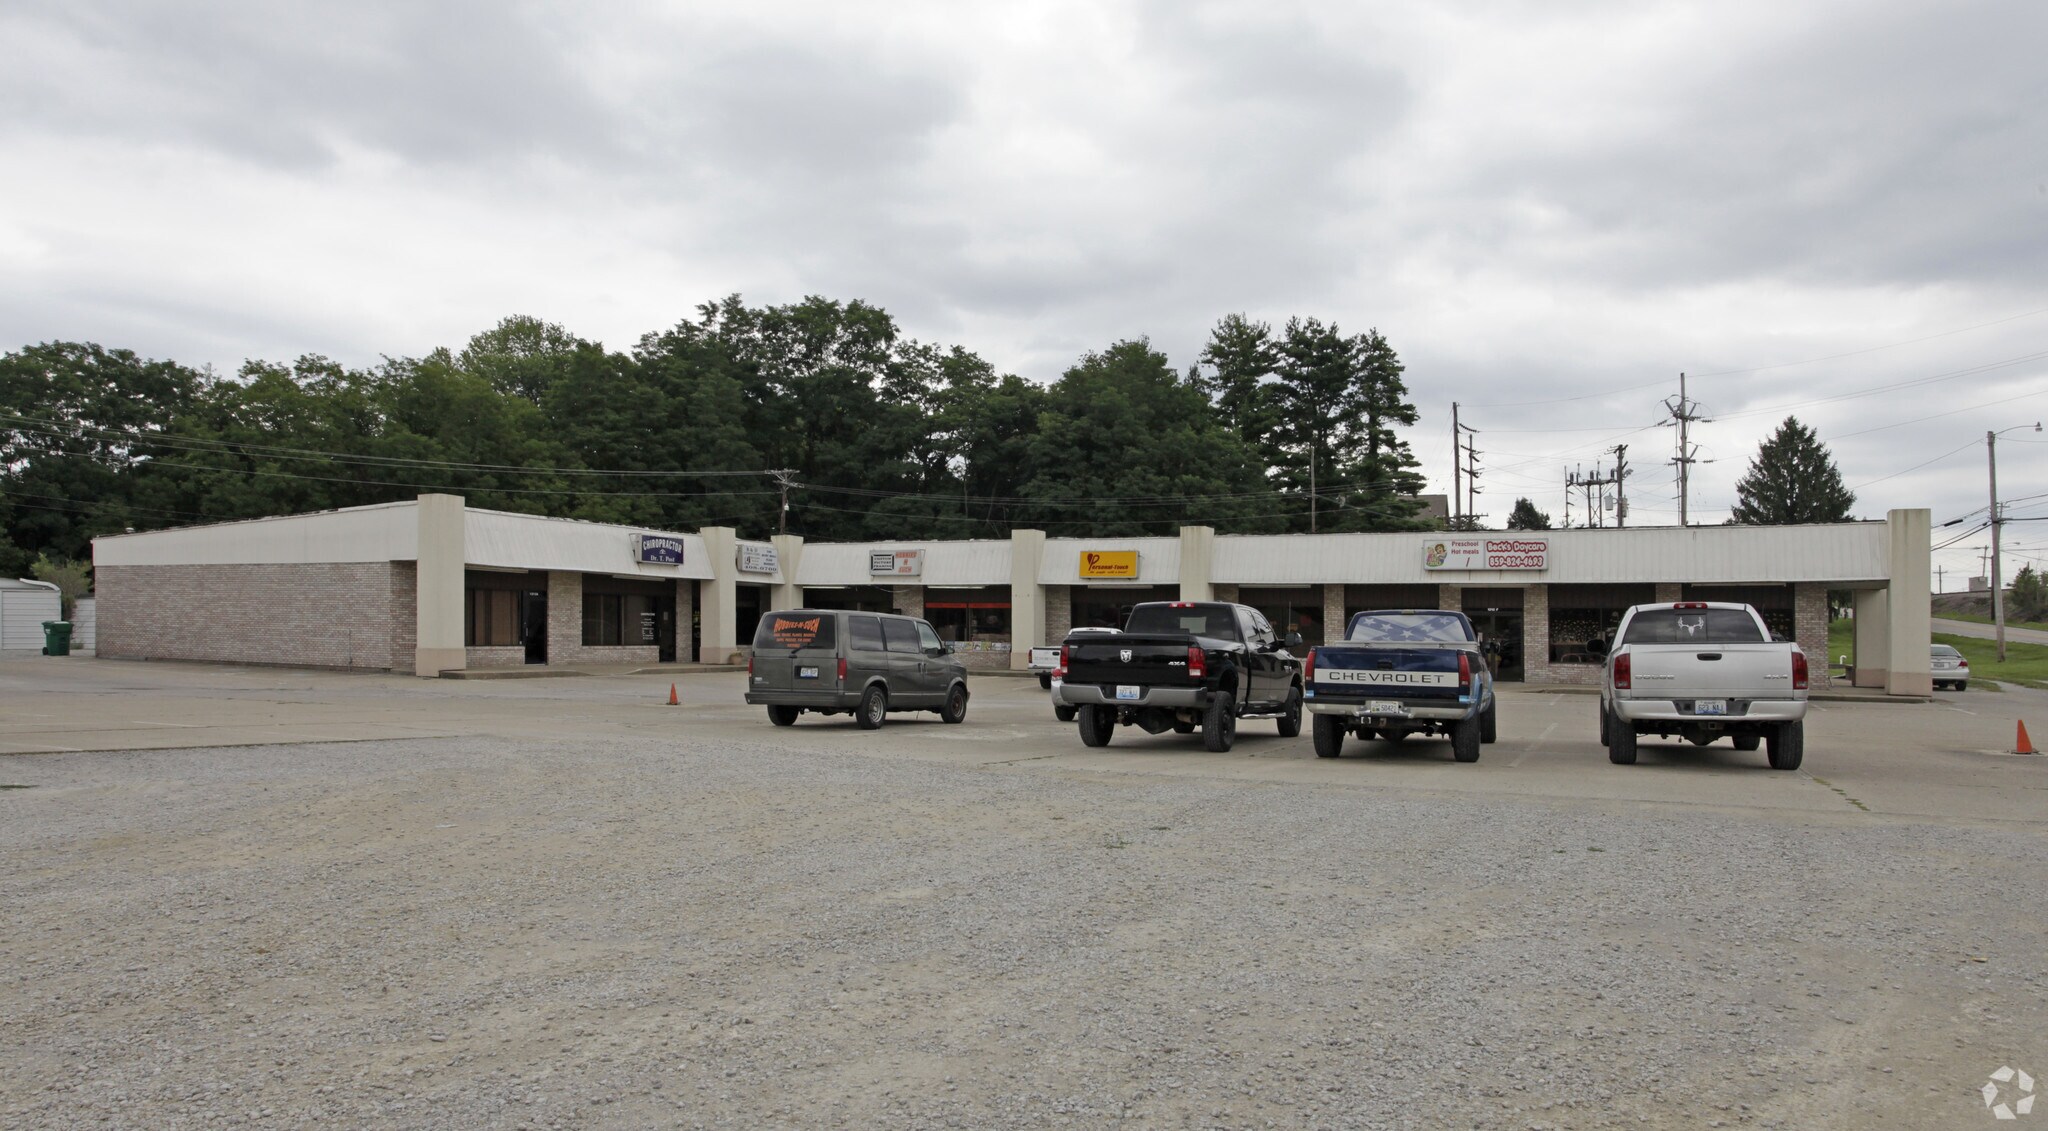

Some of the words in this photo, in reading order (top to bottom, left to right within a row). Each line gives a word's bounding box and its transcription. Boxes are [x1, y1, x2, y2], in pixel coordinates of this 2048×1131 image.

[643, 539, 683, 553] CHIROPRACTOR
[1513, 541, 1546, 554] Daycare
[1489, 556, 1544, 567] 859-824-4693
[1329, 671, 1444, 683] CHEVROLET
